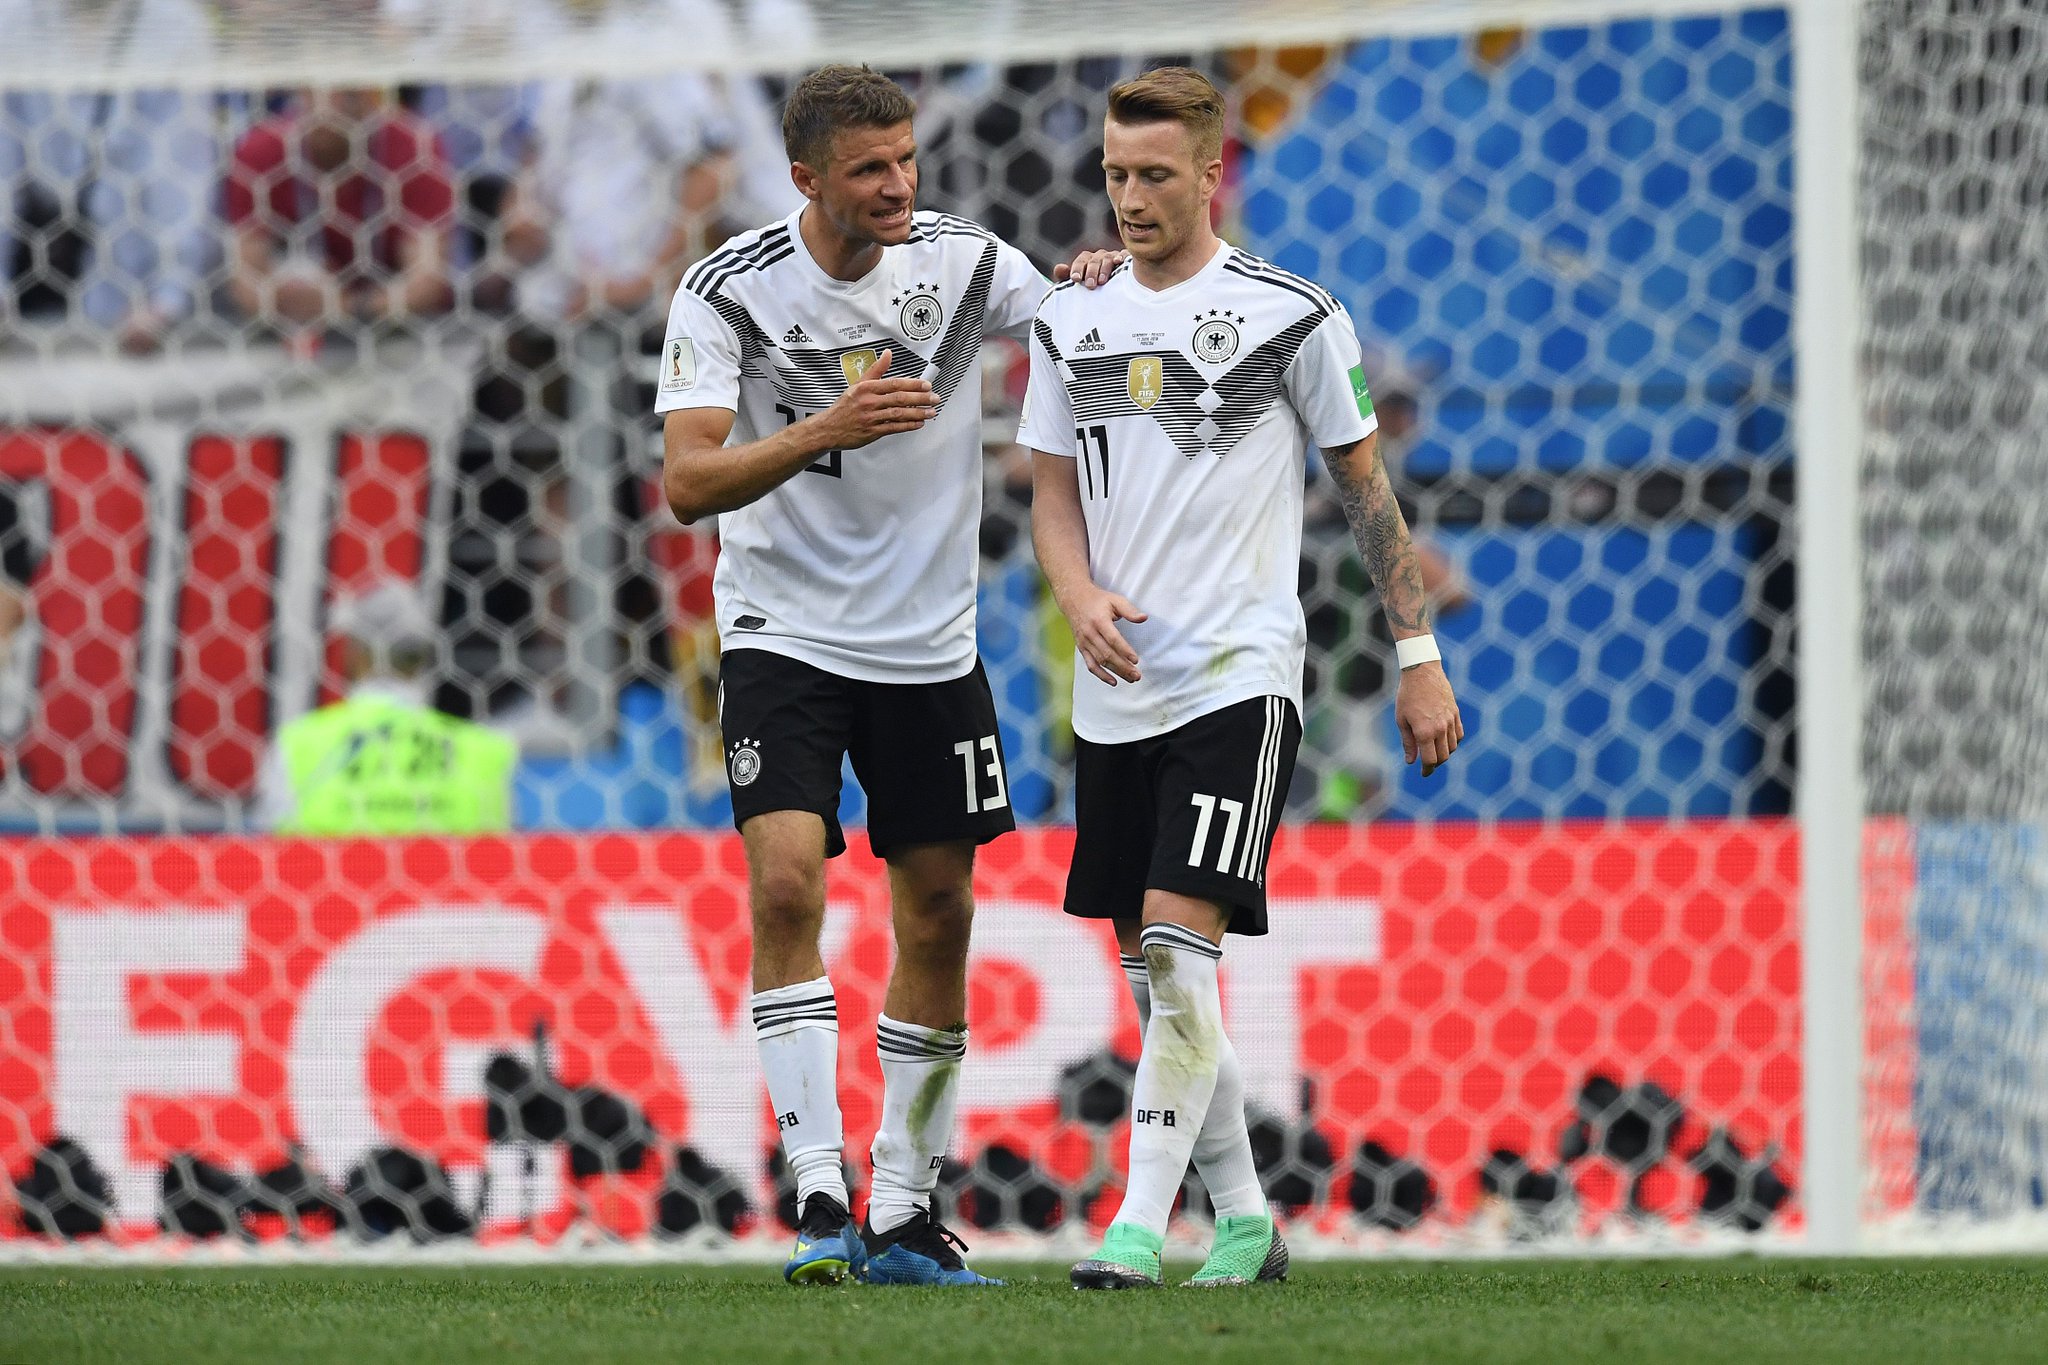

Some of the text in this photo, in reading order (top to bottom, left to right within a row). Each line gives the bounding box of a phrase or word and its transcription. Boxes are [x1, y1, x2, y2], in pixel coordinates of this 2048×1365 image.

[783, 334, 815, 343] adida
[1075, 342, 1106, 353] adidas
[1138, 390, 1155, 398] FIFA
[1076, 424, 1109, 501] 11
[954, 734, 1008, 814] 13
[1188, 792, 1243, 875] 11
[51, 897, 1379, 1228] EGYPT
[776, 1111, 799, 1131] FB
[1137, 1109, 1177, 1128] DFB
